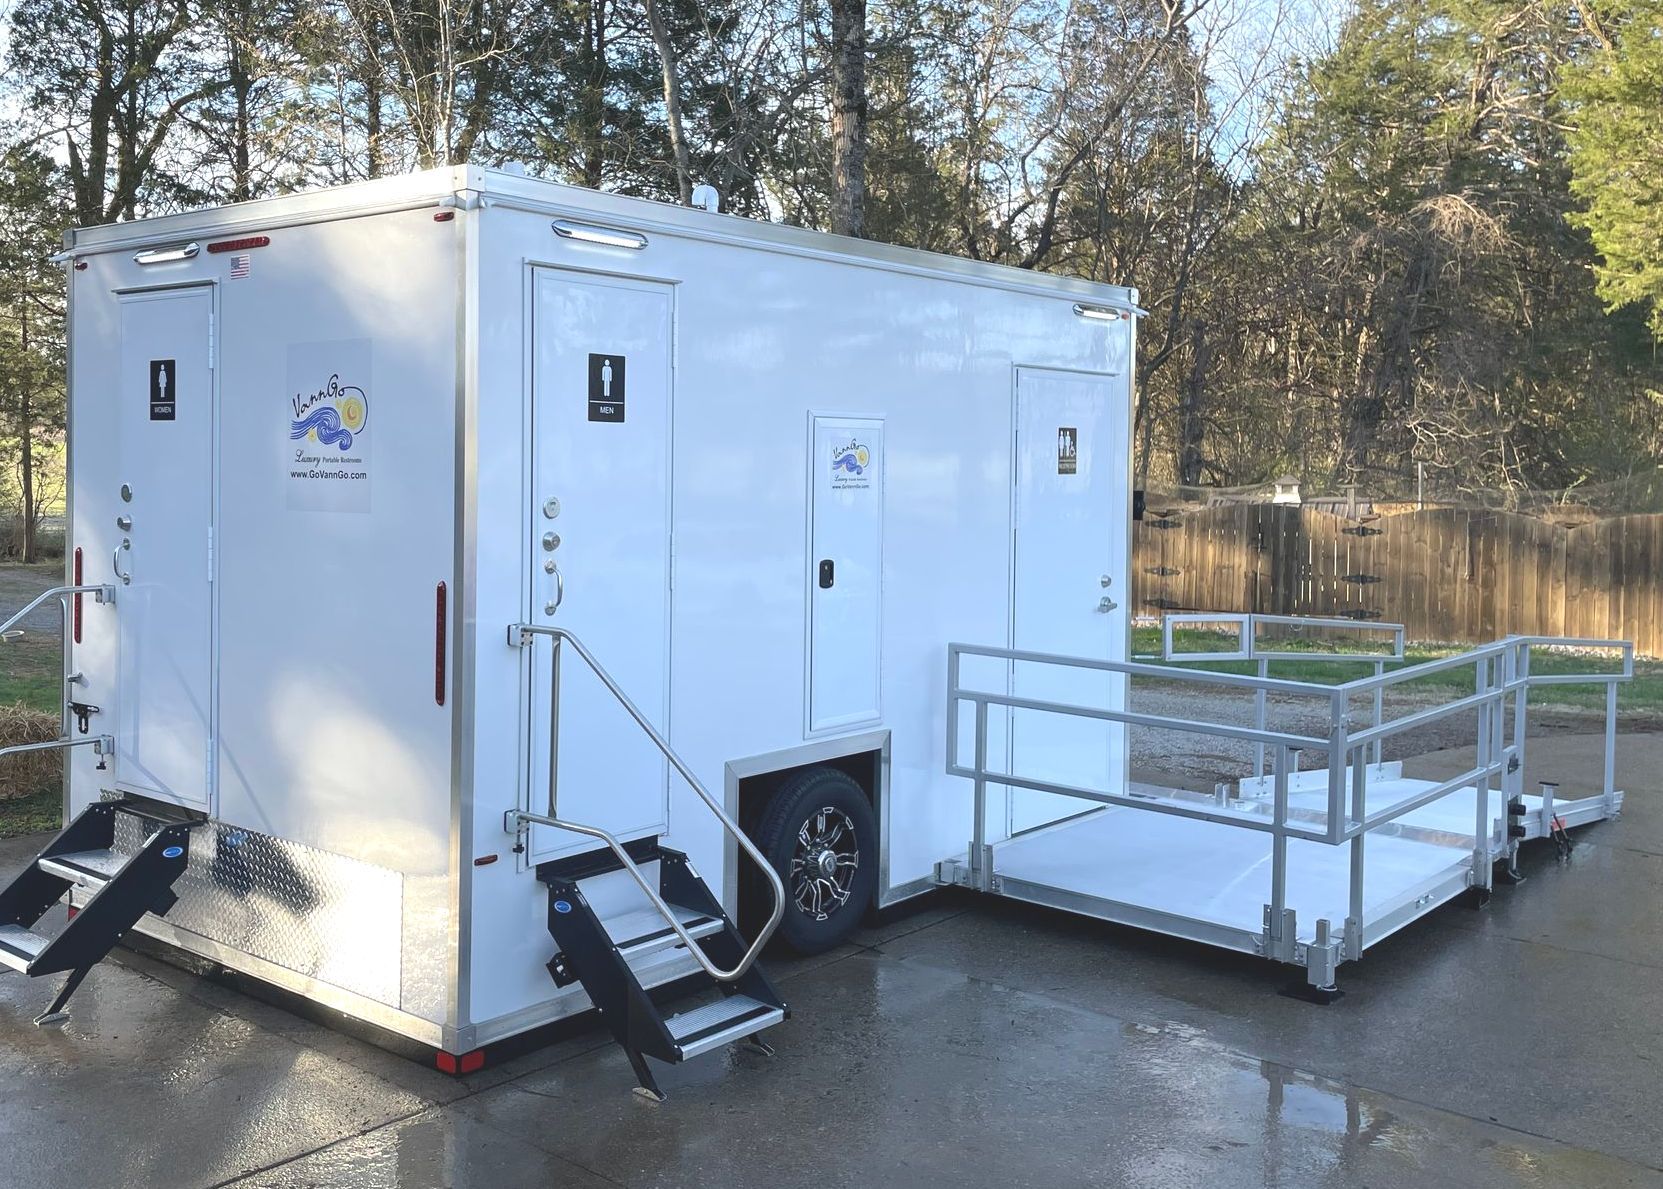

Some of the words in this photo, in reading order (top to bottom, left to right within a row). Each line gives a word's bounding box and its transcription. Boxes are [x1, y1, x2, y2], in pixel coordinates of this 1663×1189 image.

[293, 374, 346, 418] VannGo
[599, 406, 614, 414] MEN
[290, 470, 367, 479] www.GoVannGo.com
